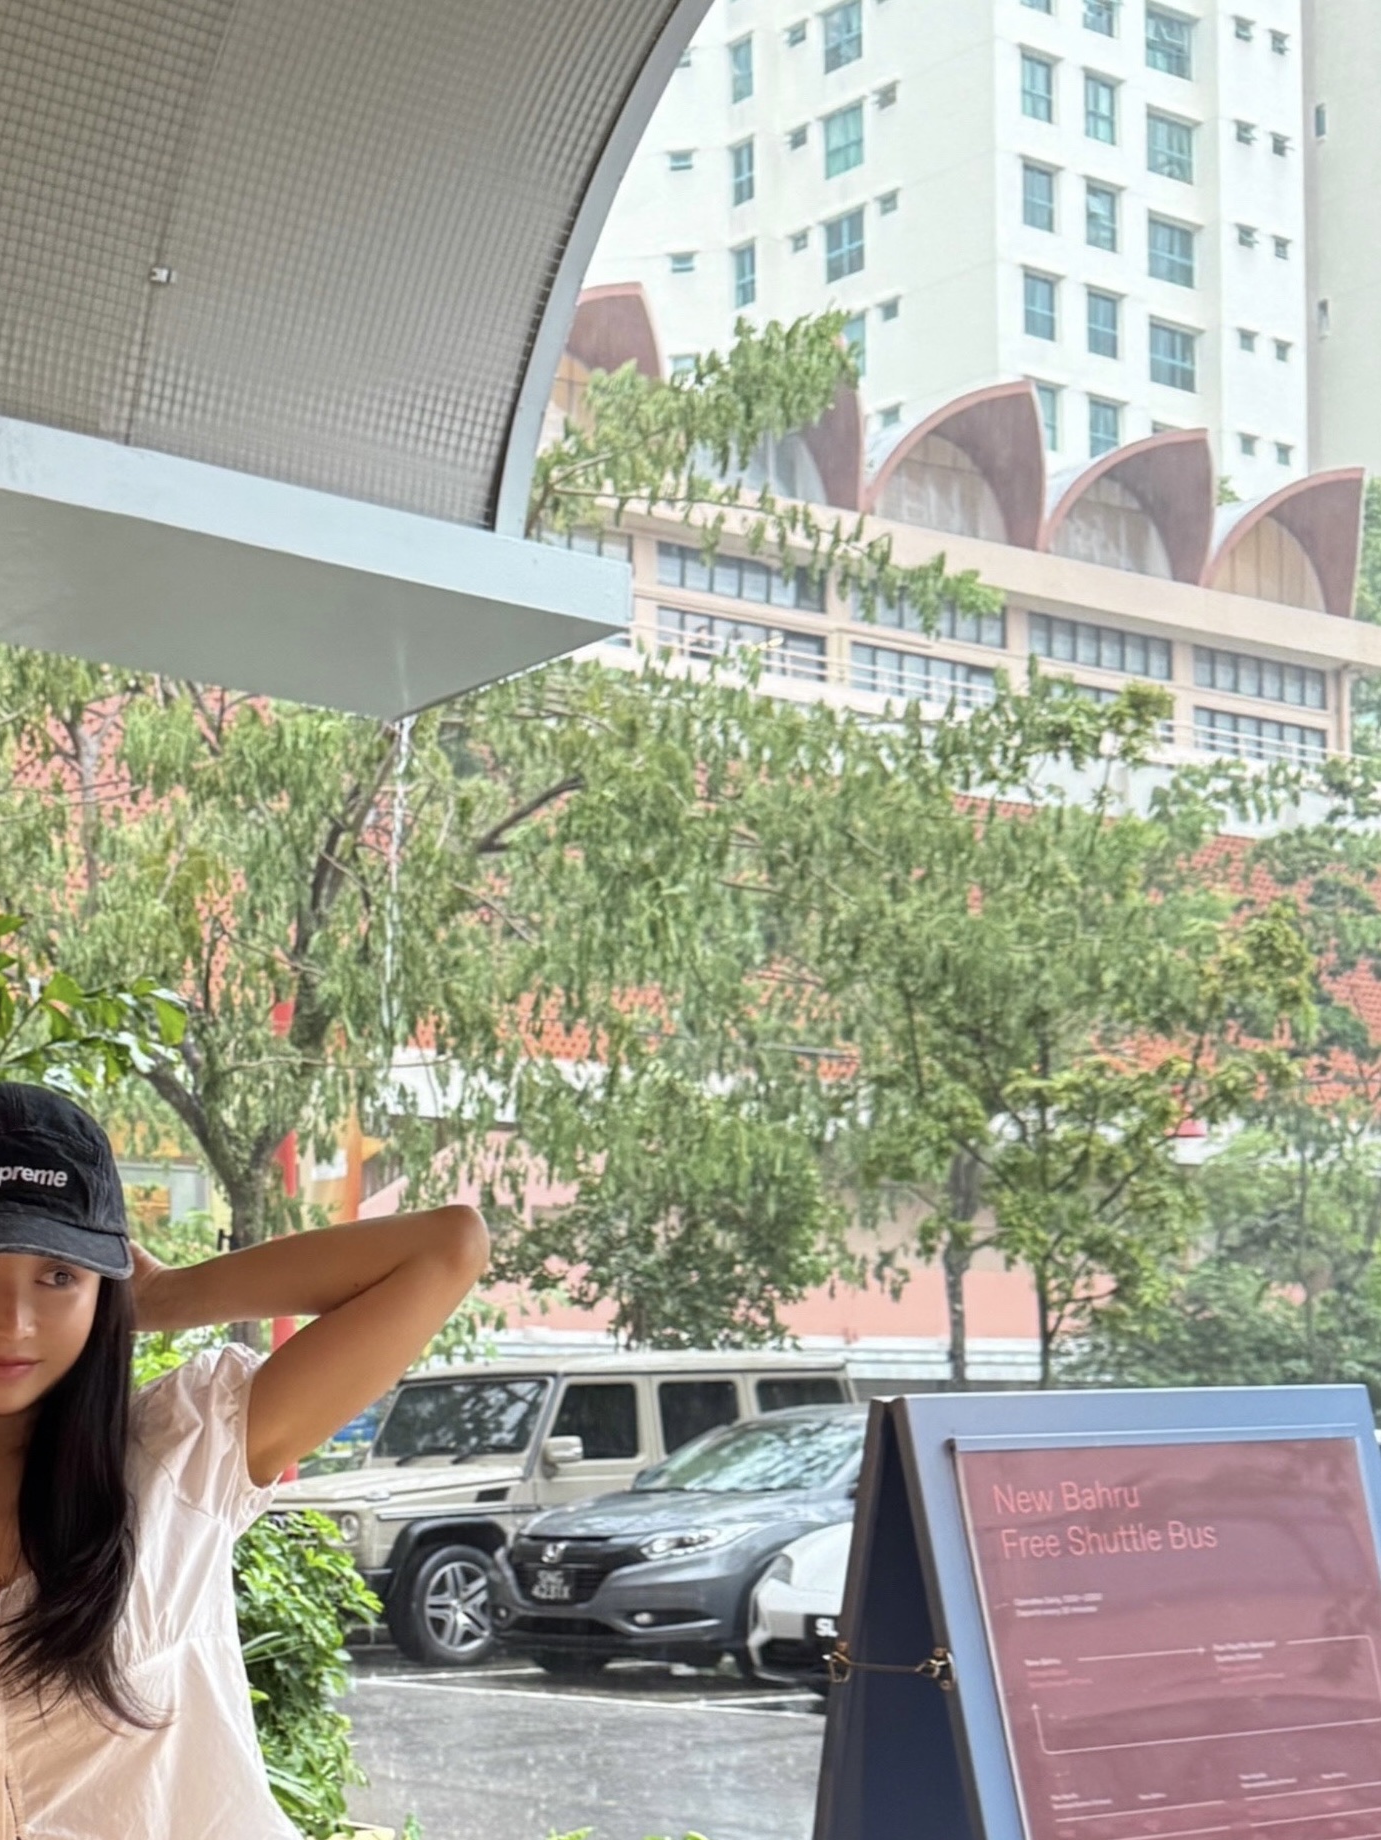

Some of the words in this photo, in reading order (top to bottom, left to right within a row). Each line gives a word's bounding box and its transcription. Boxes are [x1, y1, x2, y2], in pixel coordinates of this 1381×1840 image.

[992, 1483, 1054, 1514] New
[1060, 1480, 1142, 1512] Bahru
[1000, 1528, 1061, 1560] Free
[1067, 1522, 1164, 1557] Shuttle
[1168, 1520, 1218, 1551] Bus
